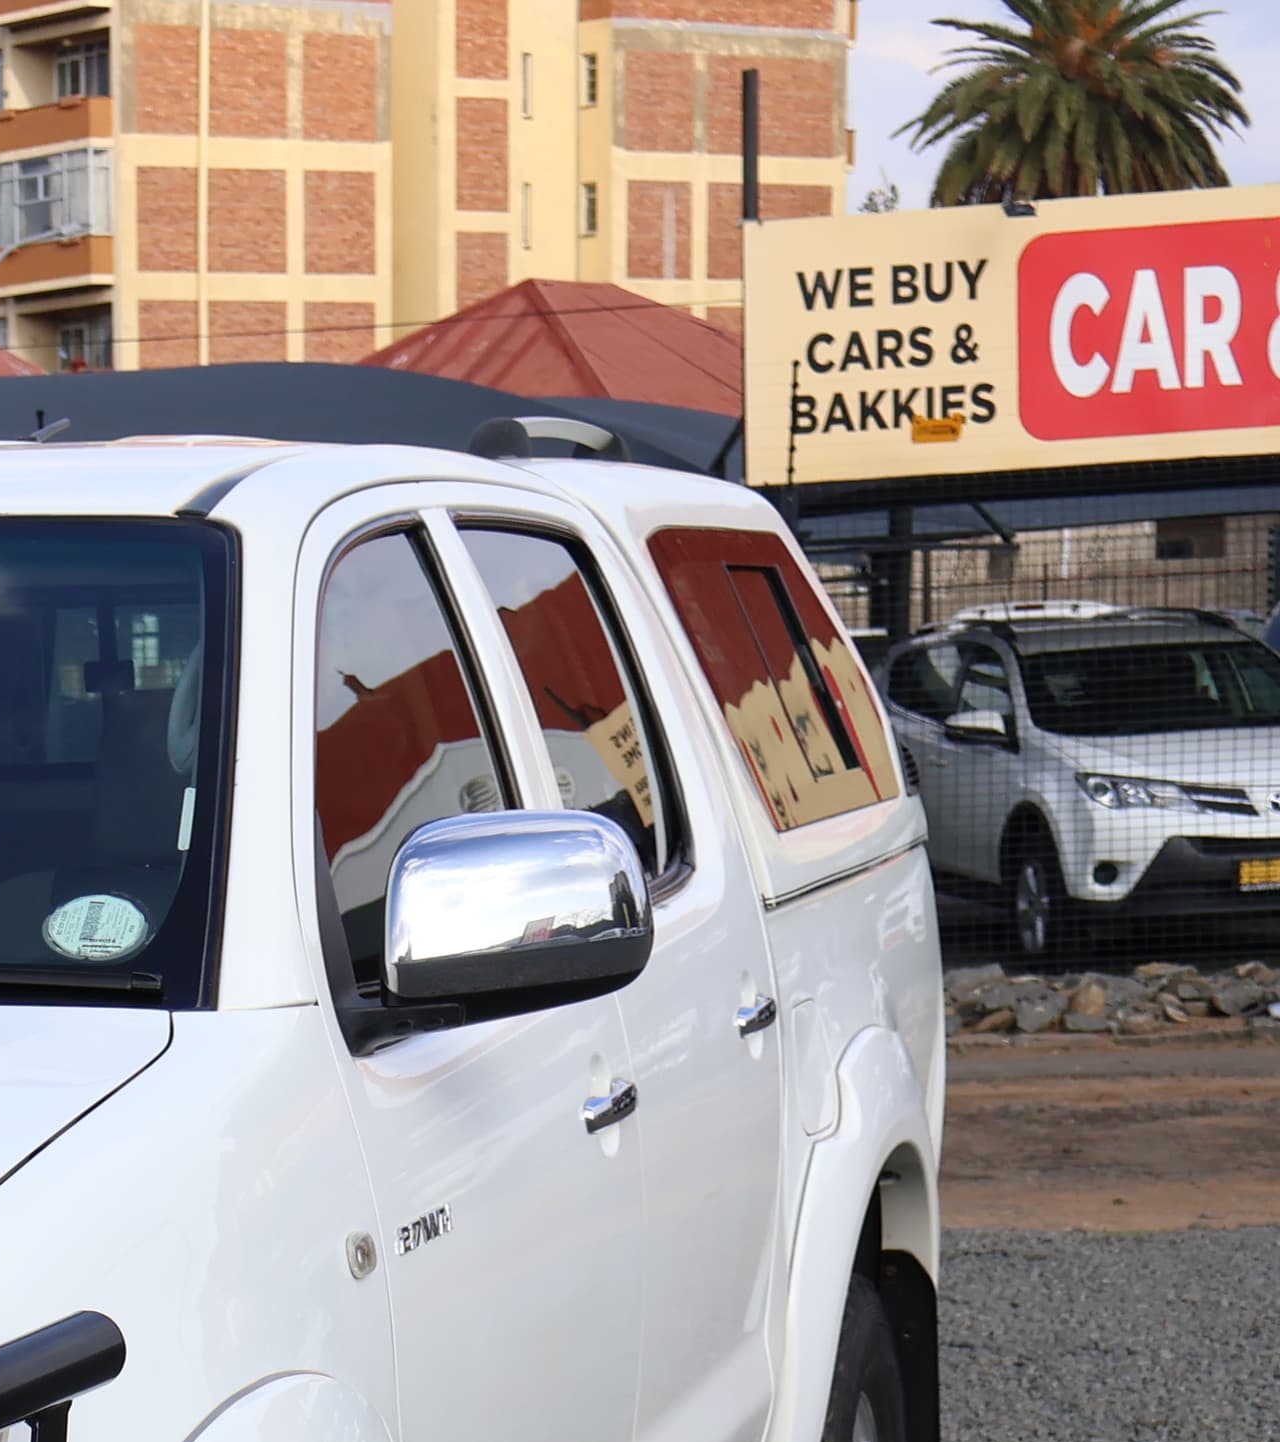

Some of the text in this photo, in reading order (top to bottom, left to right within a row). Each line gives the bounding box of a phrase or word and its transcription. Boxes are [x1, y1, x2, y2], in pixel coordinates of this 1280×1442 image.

[795, 259, 988, 311] WE BUY
[806, 323, 979, 374] CARS &
[1049, 265, 1243, 399] CAR
